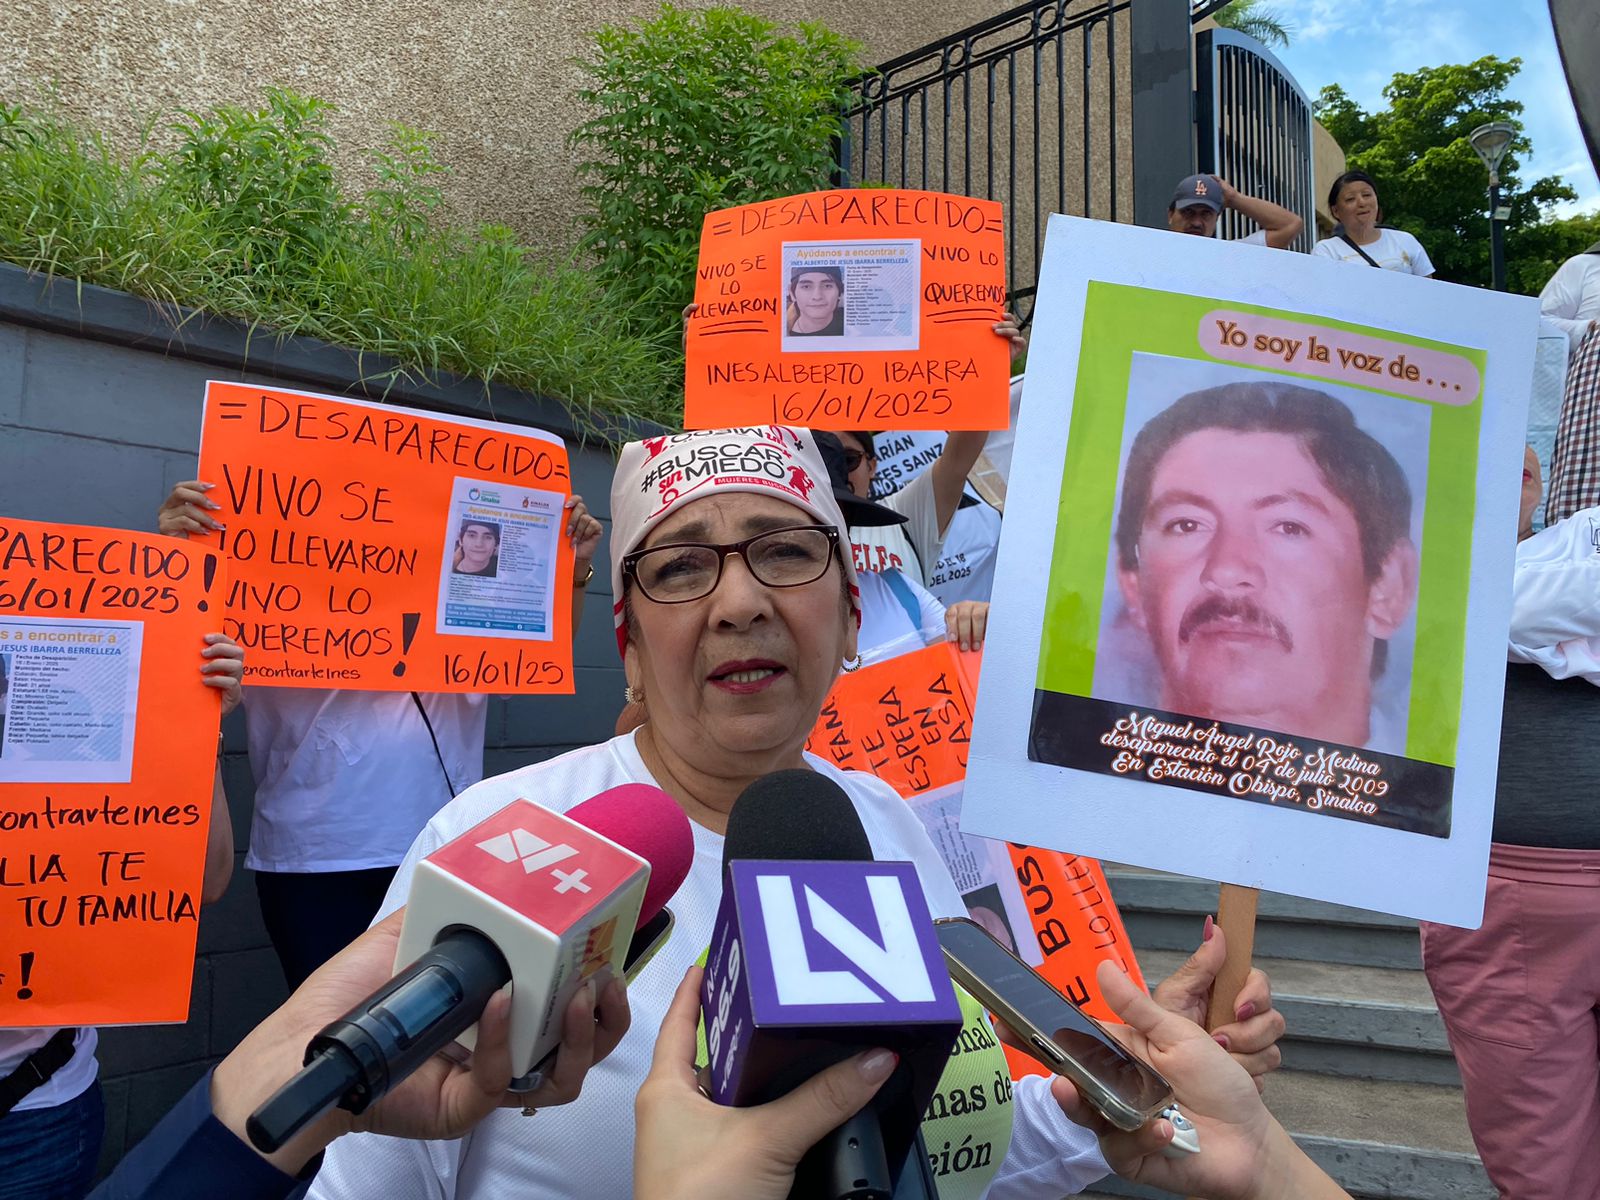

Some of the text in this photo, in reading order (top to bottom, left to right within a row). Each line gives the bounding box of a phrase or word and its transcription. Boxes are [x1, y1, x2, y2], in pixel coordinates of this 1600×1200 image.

[1194, 179, 1208, 196] LA
[700, 254, 767, 282] VIVO SE
[923, 245, 999, 267] VIVO LO
[720, 279, 741, 297] LO
[924, 281, 1006, 307] QUEREMOS
[692, 298, 778, 320] LLEVARON
[1215, 318, 1249, 348] Yo
[1253, 332, 1303, 364] soy
[1306, 335, 1331, 364] la
[1336, 347, 1386, 369] voz
[884, 357, 979, 383] IBARRA
[772, 387, 953, 423] 16/01/2025
[641, 443, 785, 494] #BUSCAR
[658, 456, 786, 495] sin MIEDO
[222, 463, 394, 524] VIVO SE
[270, 527, 418, 577] LLEVARON
[948, 566, 972, 581] 2025
[328, 584, 372, 615] LO
[28, 631, 104, 644] encontrar
[30, 645, 66, 654] IBARRA
[443, 649, 564, 687] 16/01/25
[878, 685, 931, 792] ESPERA
[913, 706, 942, 746] EN
[1114, 711, 1381, 776] Miguel Ángel Rojo Medina
[860, 729, 891, 777] TE
[1100, 729, 1391, 797] desaparecido el 04 de julio 2009
[1111, 750, 1378, 816] En Estación Obispo, Sinaloa
[98, 850, 146, 887] TE
[17, 889, 198, 928] TU FAMILIA
[1012, 843, 1072, 957] BUS
[1088, 915, 1118, 950] LO
[993, 1070, 1013, 1106] de
